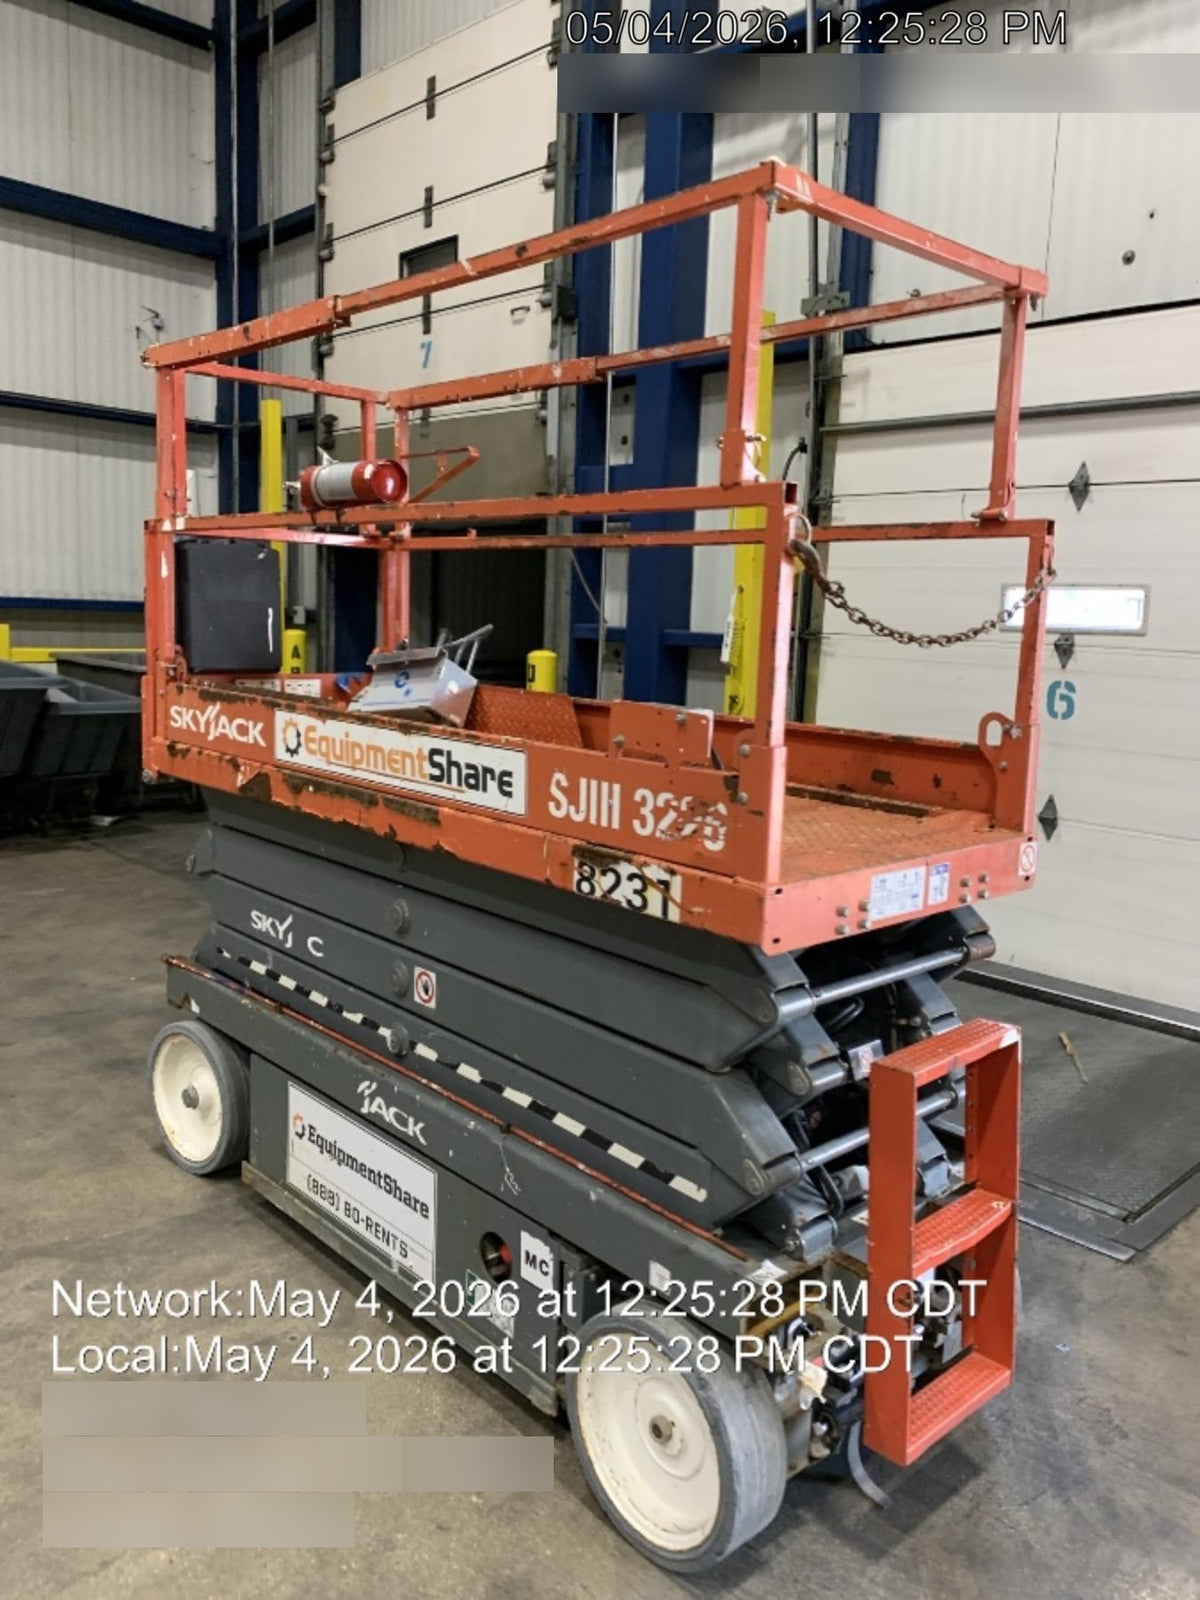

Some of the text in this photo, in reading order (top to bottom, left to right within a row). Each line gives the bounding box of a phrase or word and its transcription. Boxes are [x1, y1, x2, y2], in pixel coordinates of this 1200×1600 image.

[420, 341, 432, 369] 7
[1046, 680, 1076, 720] 6
[169, 702, 267, 747] SKYJACK
[304, 724, 514, 799] EquipmentShare
[575, 861, 671, 921] 8231
[306, 1124, 430, 1220] EquipmentShare
[524, 1250, 550, 1277] MC
